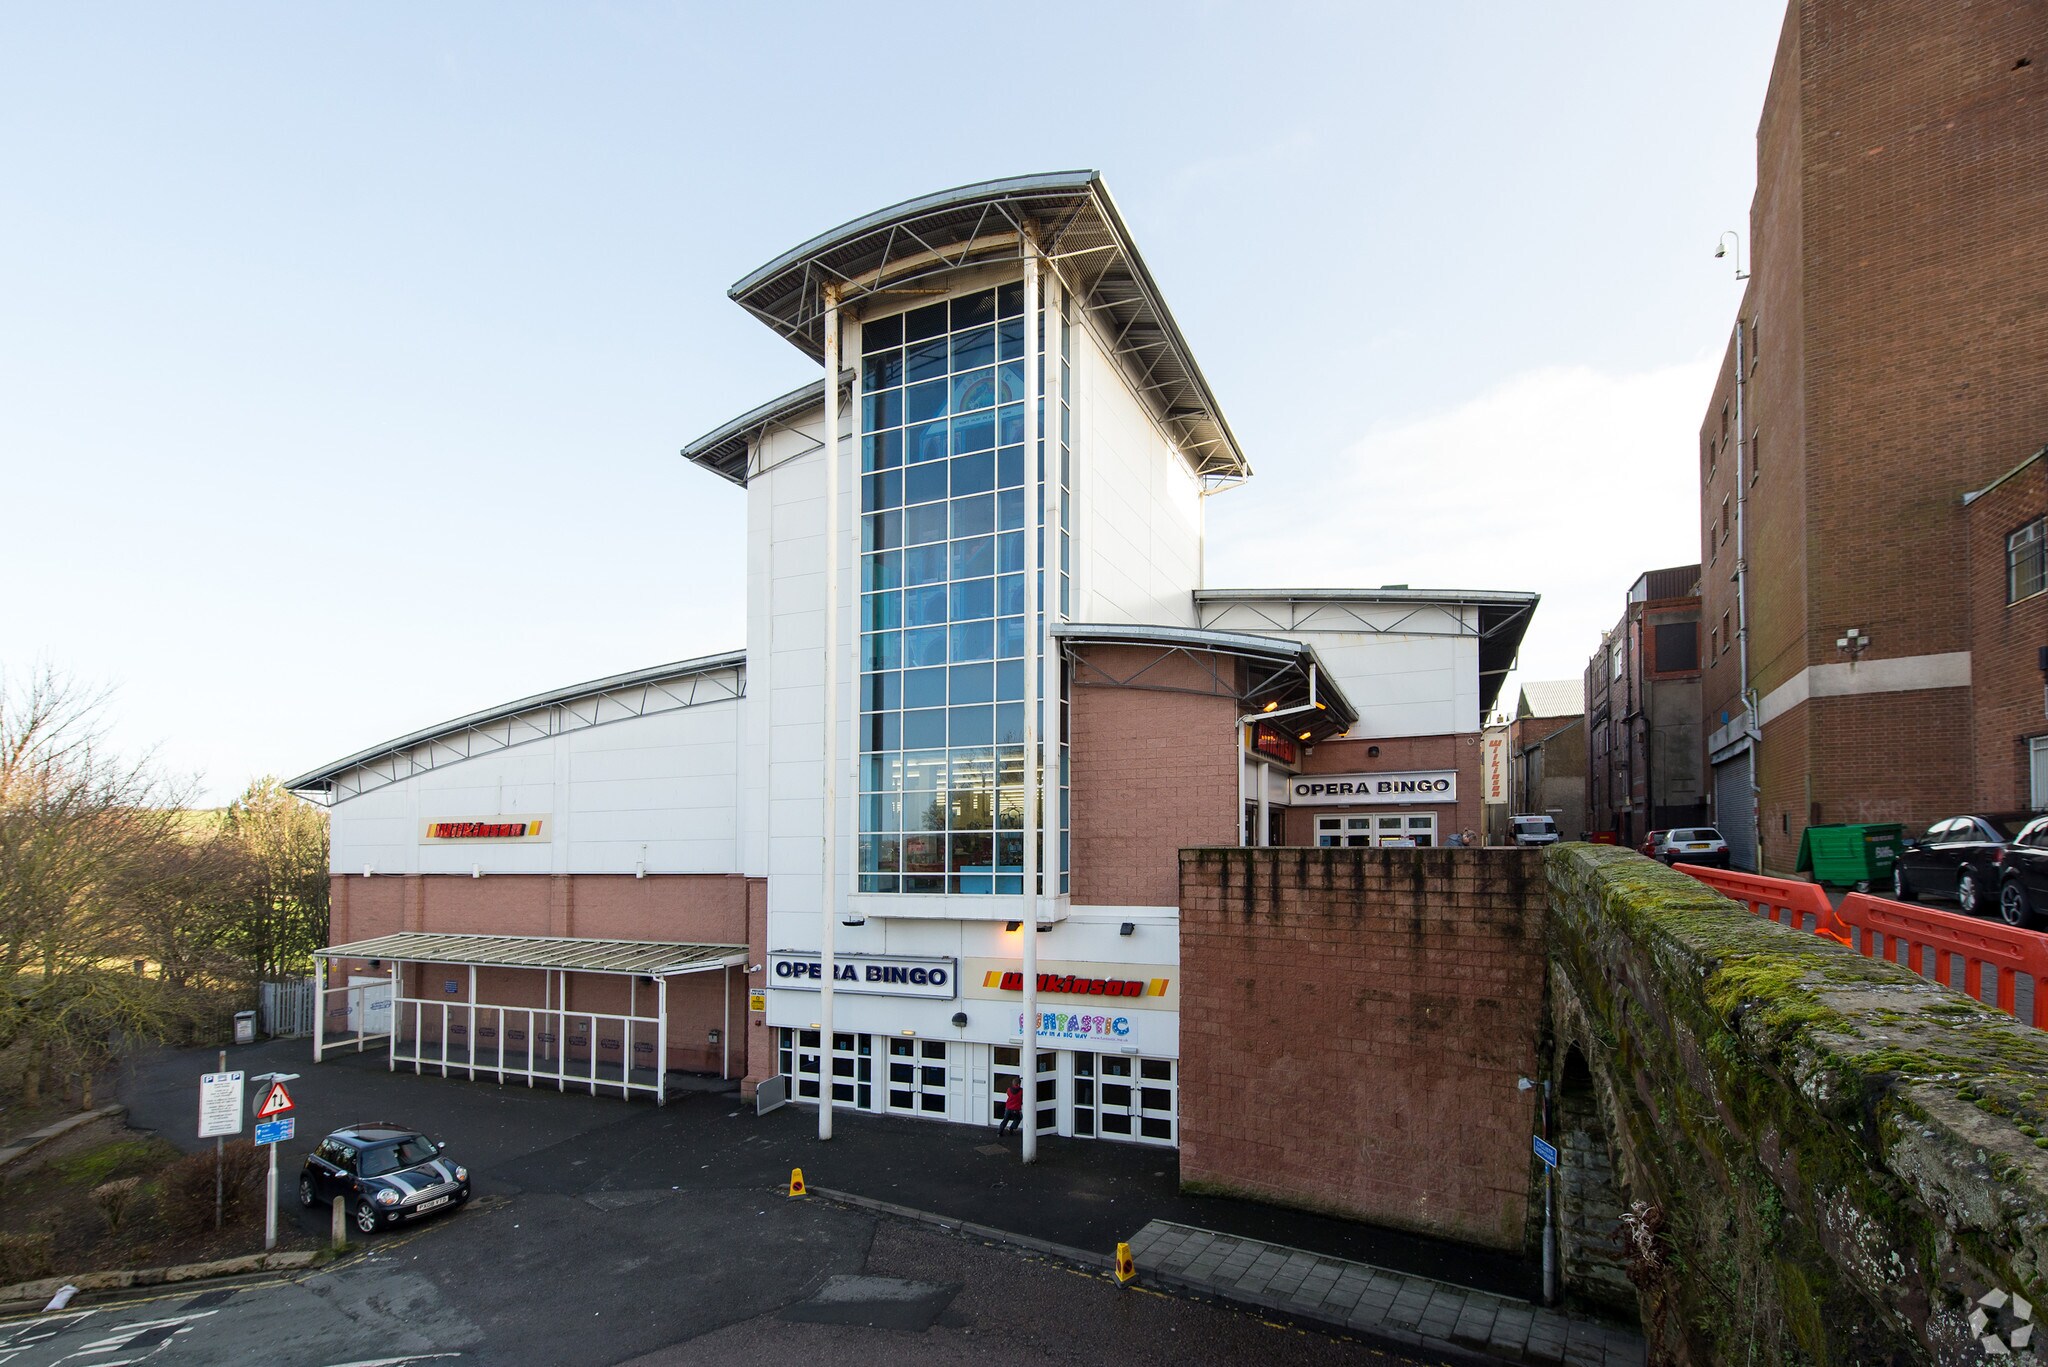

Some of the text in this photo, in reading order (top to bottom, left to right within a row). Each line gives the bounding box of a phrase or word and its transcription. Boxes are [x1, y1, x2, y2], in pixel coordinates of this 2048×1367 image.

[1489, 740, 1502, 797] Wilkinson
[1295, 779, 1450, 796] OPERA BINGO
[434, 822, 526, 838] Wilkinson
[865, 965, 948, 986] BINGO
[1000, 971, 1144, 997] Wlkinson
